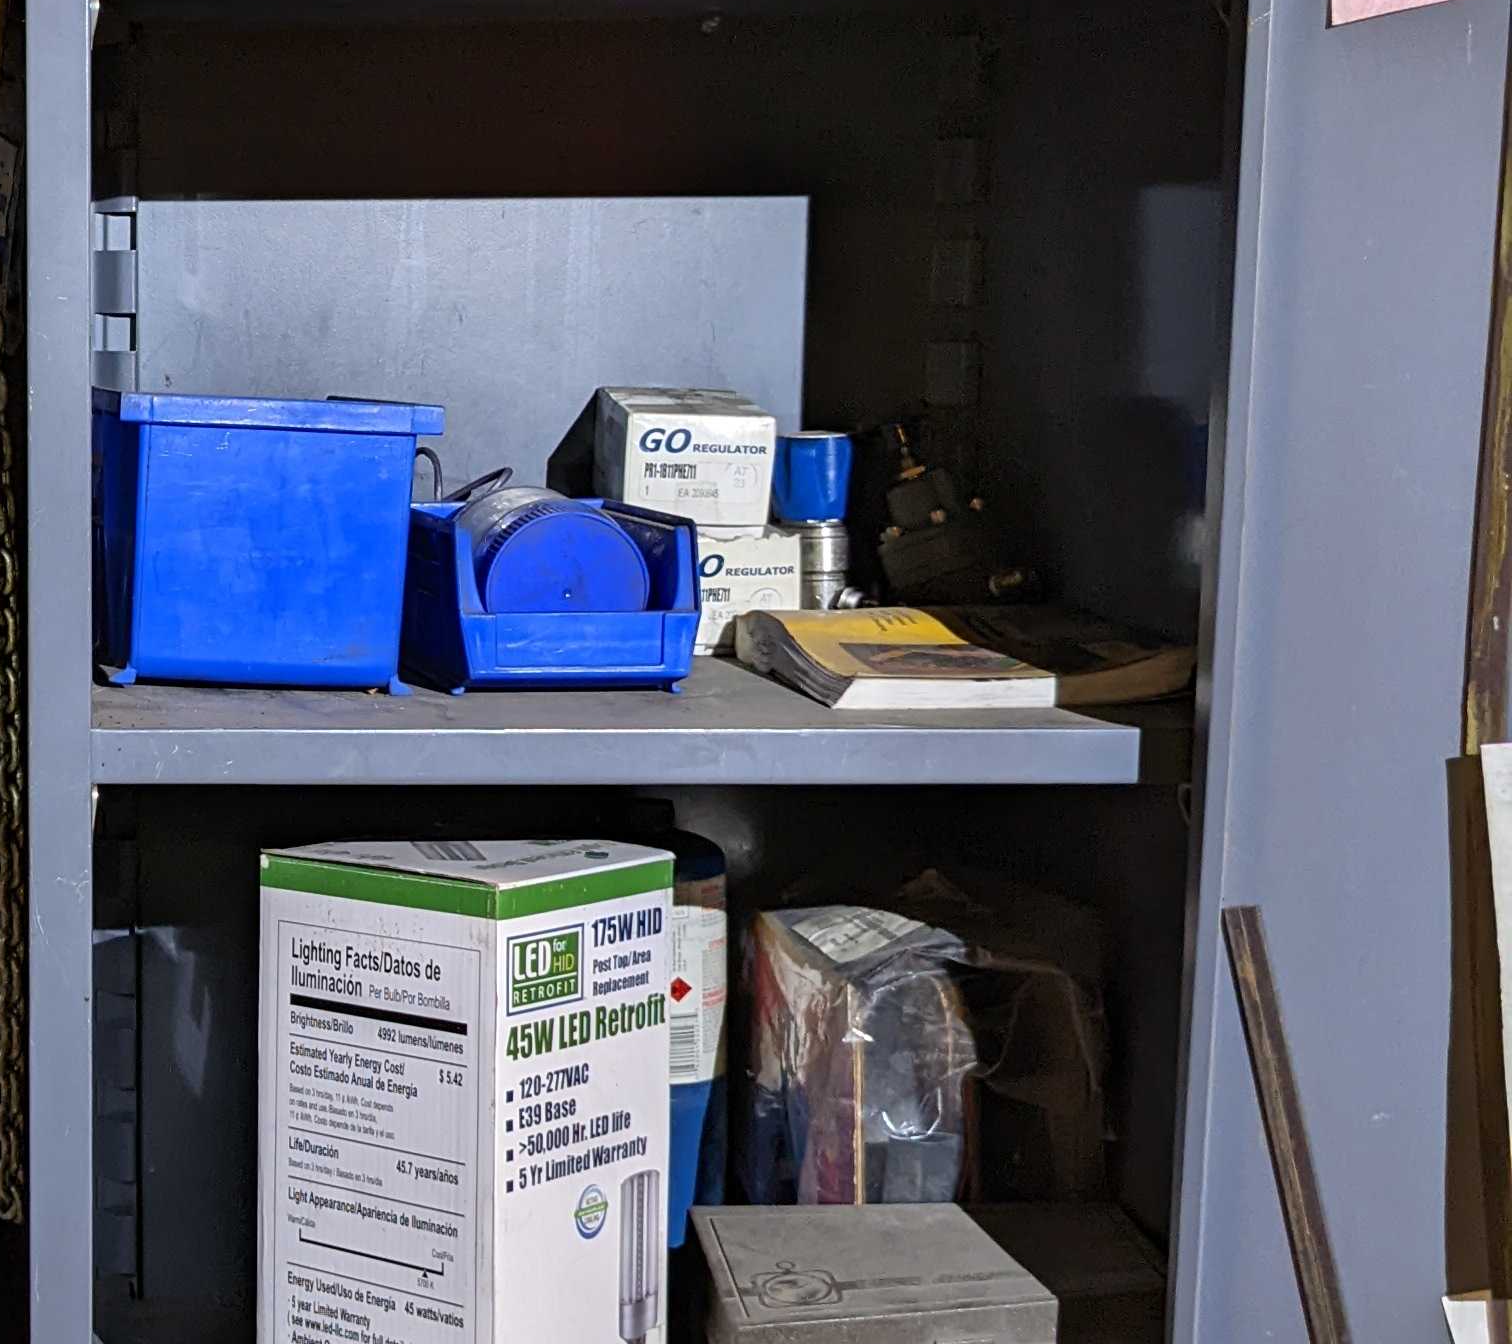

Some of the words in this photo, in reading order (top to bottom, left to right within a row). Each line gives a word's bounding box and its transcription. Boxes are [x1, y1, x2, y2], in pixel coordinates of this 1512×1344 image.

[639, 428, 692, 454] GO
[692, 443, 768, 455] REGULATOR
[699, 554, 725, 578] O
[725, 565, 795, 578] REGULATOR
[591, 911, 634, 947] 175W
[637, 907, 662, 937] HID
[292, 937, 341, 970] Lighting
[345, 946, 420, 978] Facts/Datos
[425, 959, 441, 981] de
[513, 940, 551, 981] LED
[553, 938, 568, 952] for
[552, 953, 575, 973] HID
[593, 954, 612, 974] Post
[613, 949, 651, 970] Top/Area
[292, 965, 362, 997] Iluminación
[513, 978, 576, 1005] RETROFIT
[593, 971, 649, 996] Replacement
[368, 984, 381, 999] Per
[383, 987, 415, 1005] Bulb/Por
[417, 993, 450, 1011] Bombilla
[290, 1011, 354, 1035] Brightness/Brillo
[377, 1027, 396, 1042] 4992
[506, 1018, 554, 1061] 45W
[558, 1010, 591, 1050] LED
[595, 992, 666, 1041] Retrofit
[290, 1042, 327, 1061] Estimated
[329, 1049, 352, 1068] Yearly
[354, 1053, 381, 1073] Energy
[289, 1060, 312, 1076] Costo
[314, 1065, 349, 1084] Estimado
[351, 1074, 373, 1089] Anual
[376, 1077, 385, 1091] de
[446, 1070, 463, 1087] 5.42
[519, 1062, 589, 1099] 120-277VAC
[519, 1102, 541, 1129] E39
[545, 1097, 576, 1122] Base
[590, 1115, 609, 1139] LED
[611, 1110, 631, 1133] life
[396, 1159, 412, 1175] 45.7
[519, 1171, 526, 1190] 5
[530, 1166, 543, 1187] Yr
[545, 1153, 590, 1182] Limited
[591, 1136, 647, 1168] Warranty
[288, 1186, 308, 1205] Light
[308, 1191, 398, 1225] Appearance/Apariencia
[399, 1211, 410, 1227] de
[287, 1270, 314, 1290] Energy
[316, 1278, 353, 1299] Used/Uso
[354, 1287, 364, 1302] de
[404, 1301, 414, 1316] 45
[297, 1299, 312, 1313] year
[313, 1301, 338, 1320] Limited
[340, 1307, 371, 1330] Warranty
[360, 1329, 371, 1344] for
